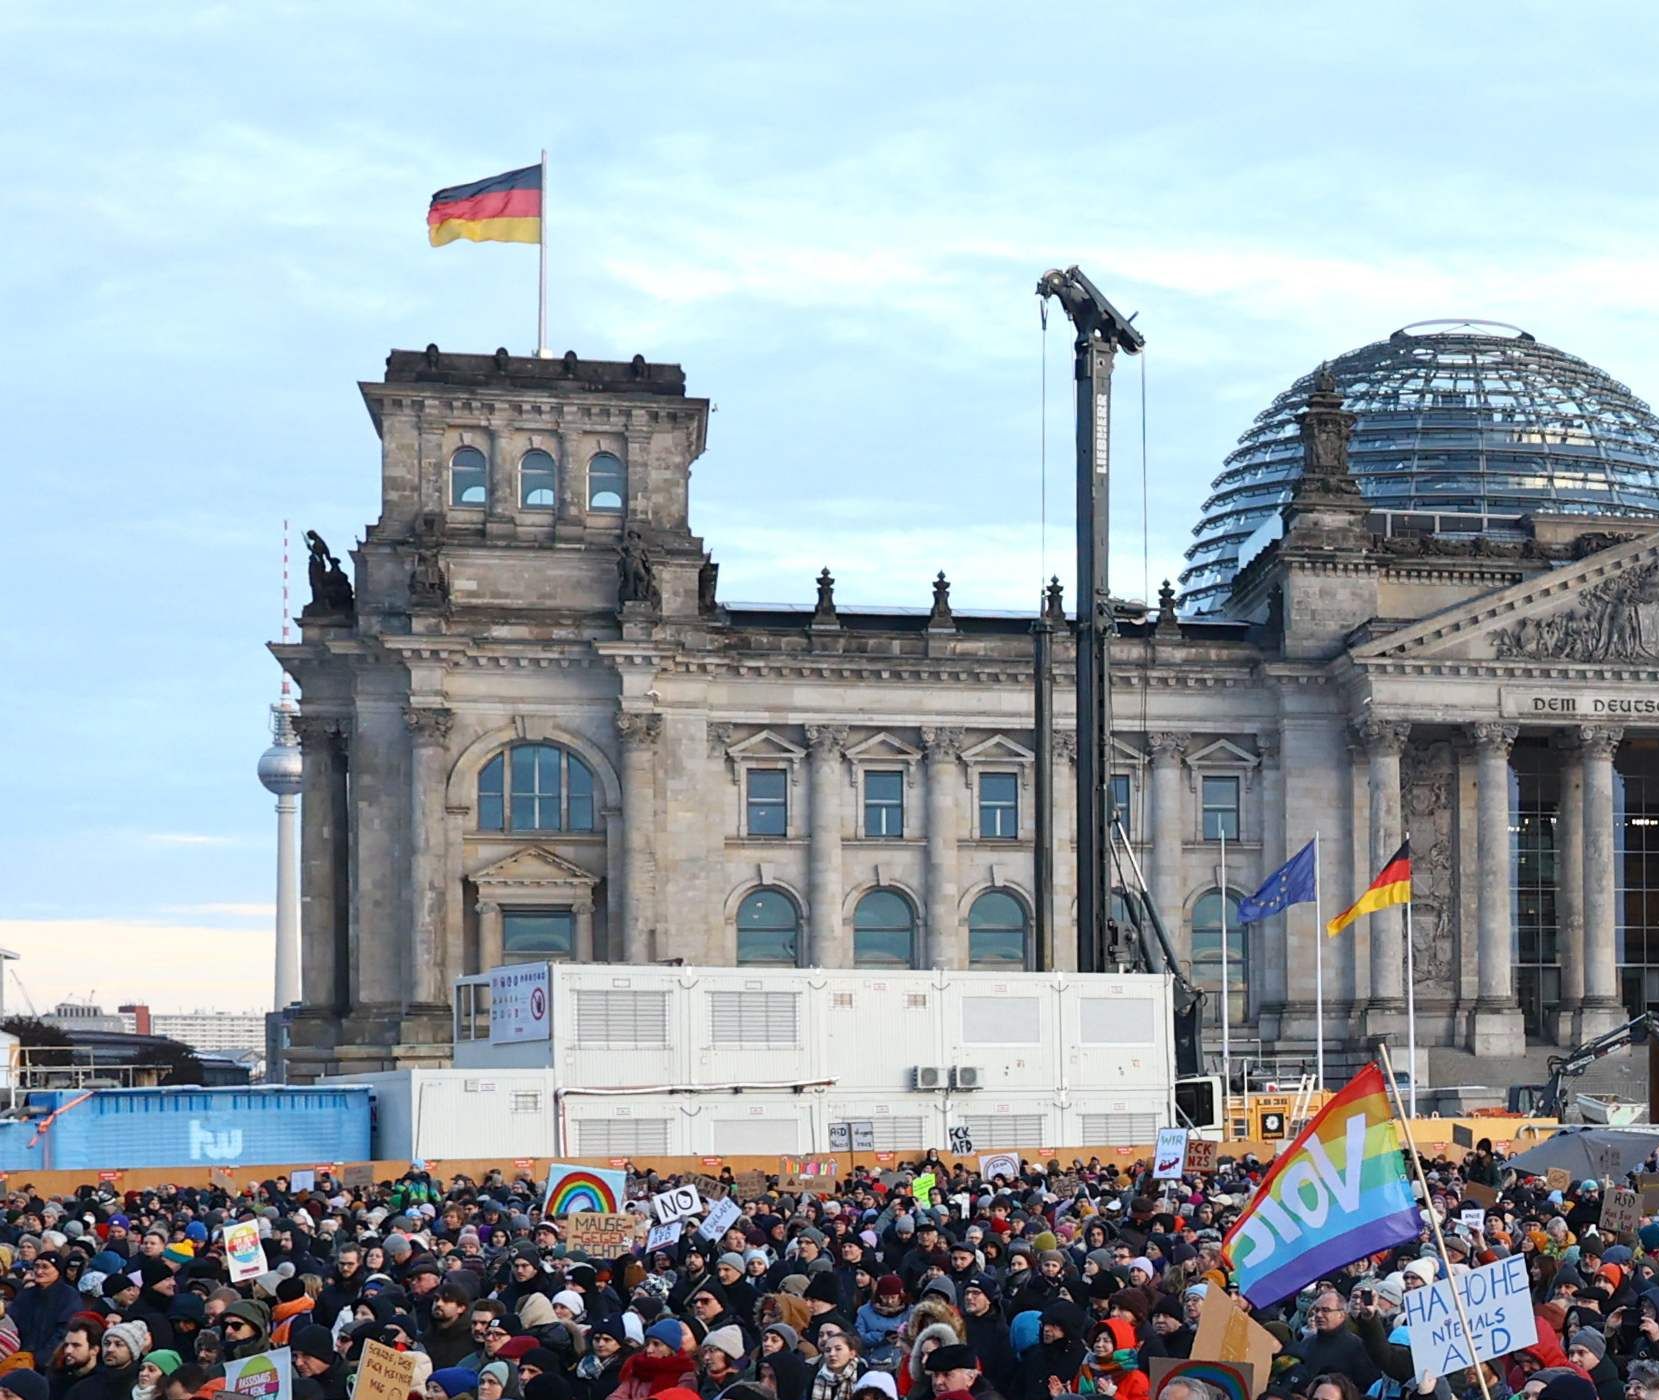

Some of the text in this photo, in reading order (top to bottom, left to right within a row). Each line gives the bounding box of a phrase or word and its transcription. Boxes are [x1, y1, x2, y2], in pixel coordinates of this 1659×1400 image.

[1532, 697, 1576, 712] DEM
[949, 1127, 970, 1142] FCK
[1161, 1135, 1183, 1145] WIR
[660, 1190, 694, 1218] NO
